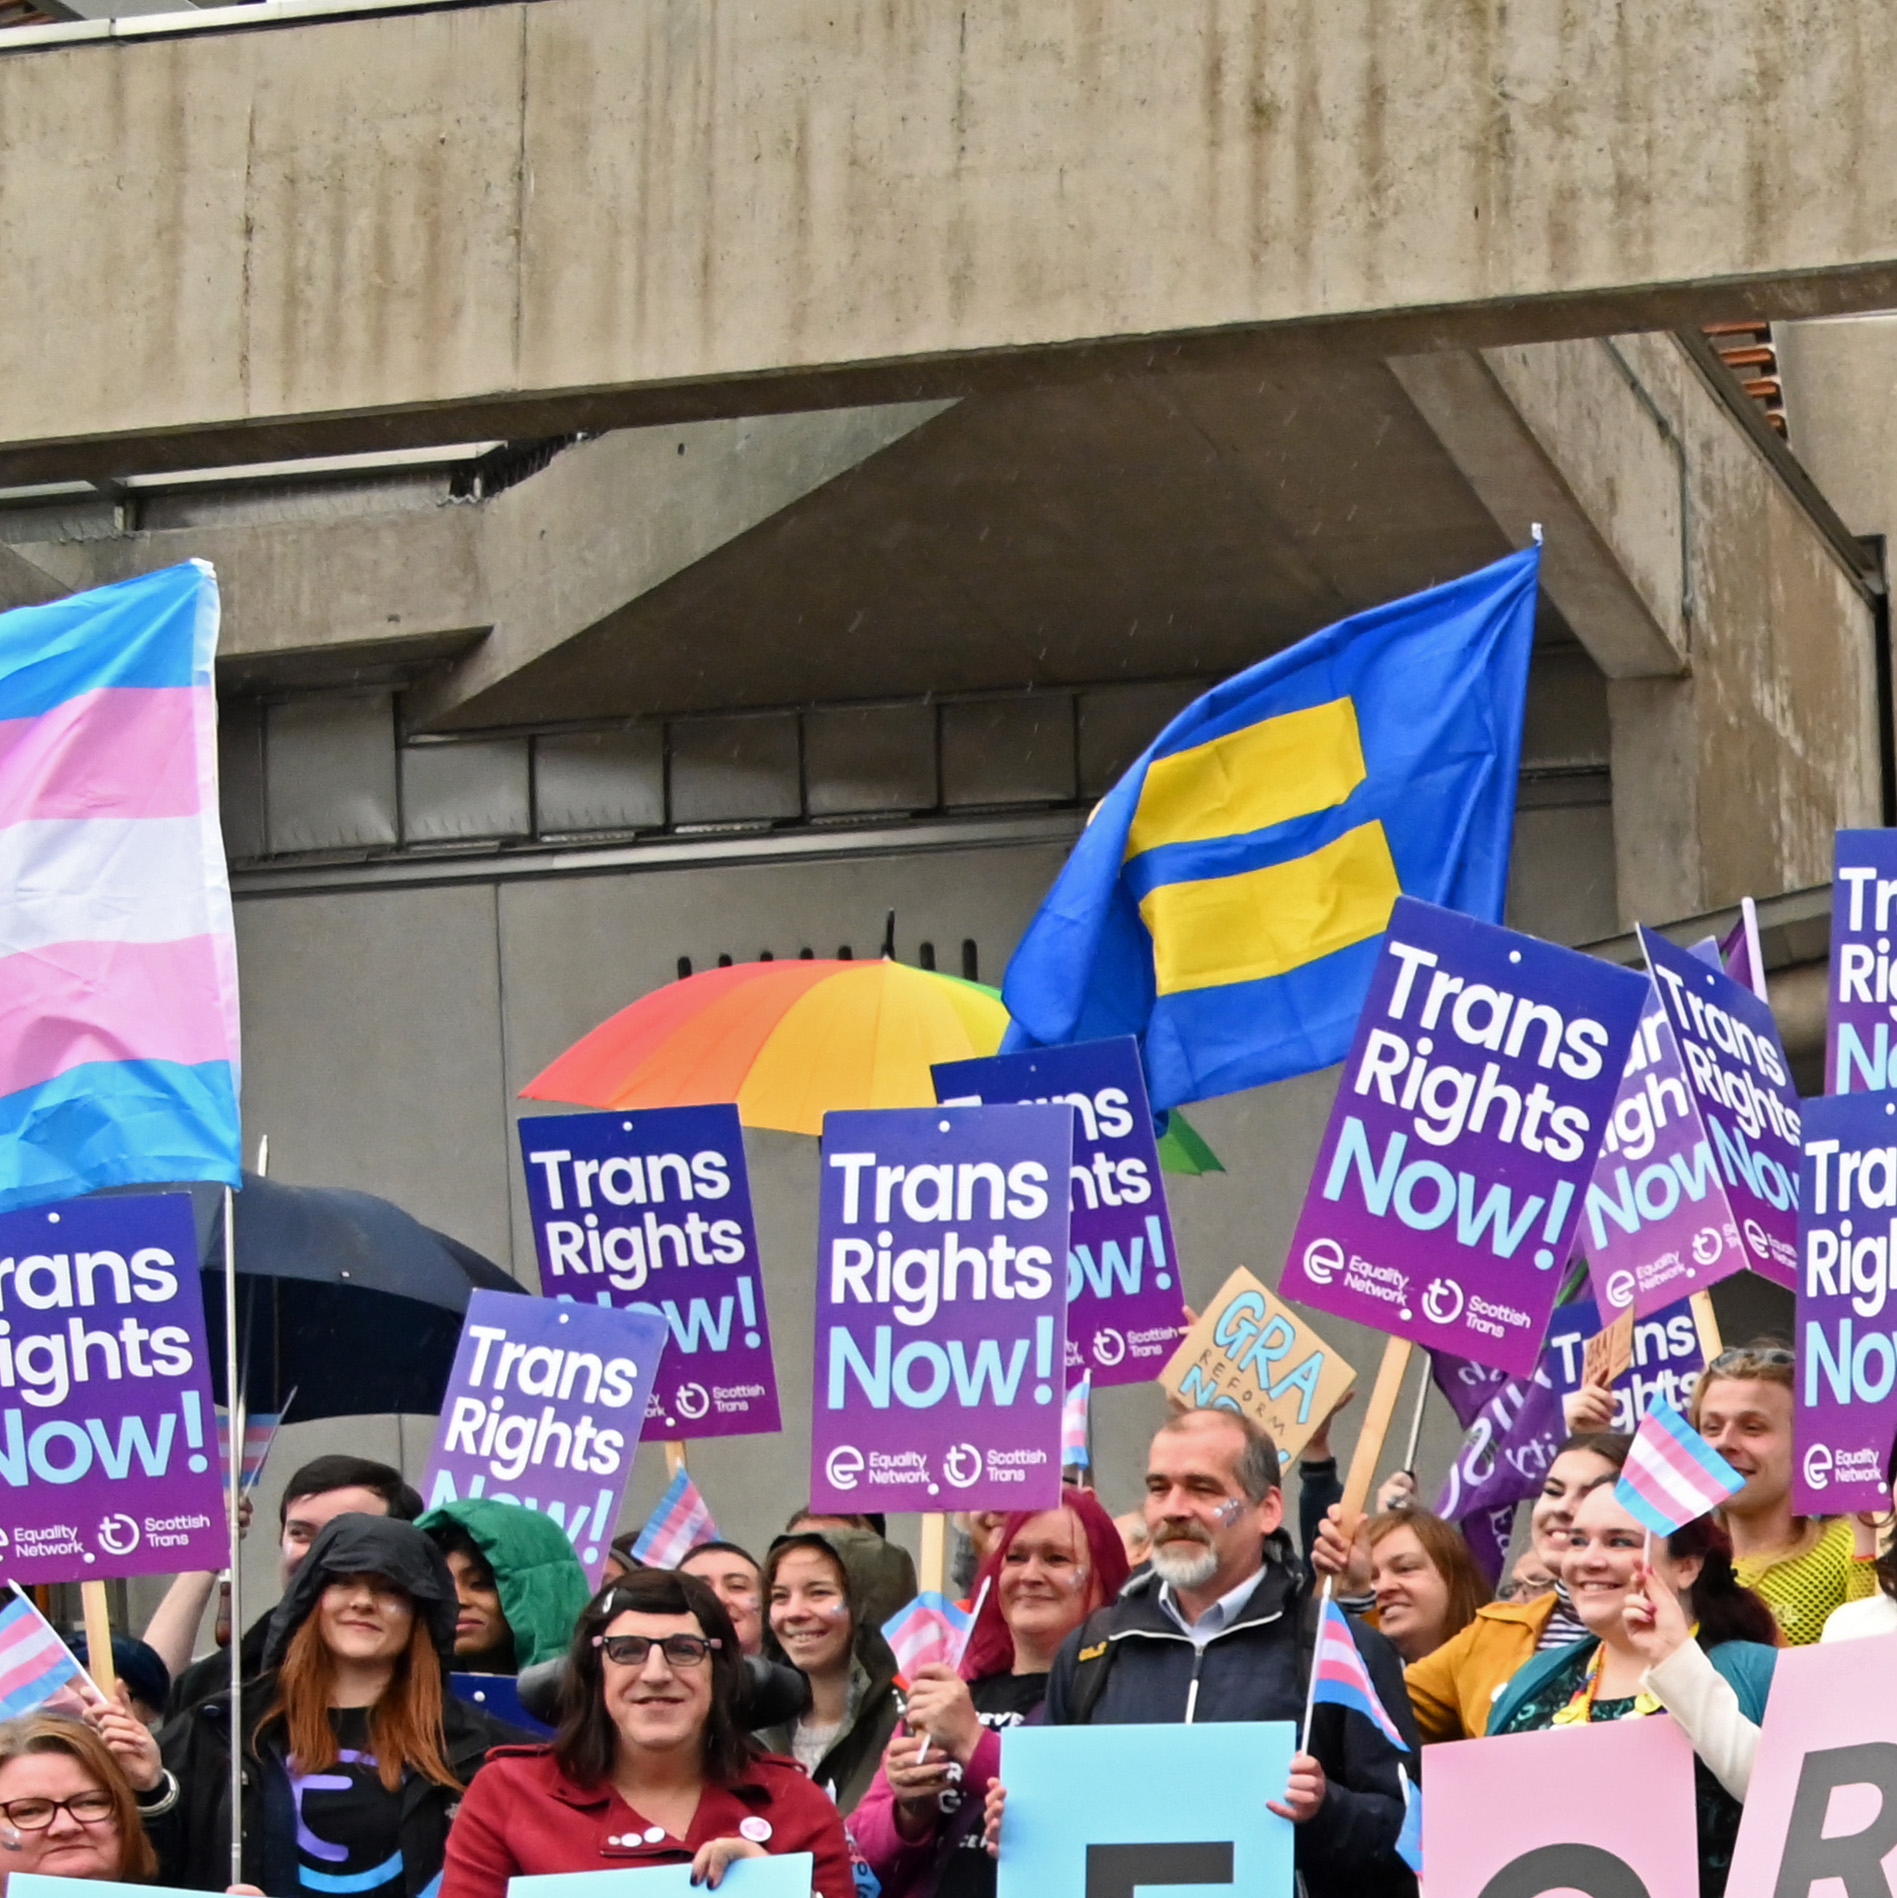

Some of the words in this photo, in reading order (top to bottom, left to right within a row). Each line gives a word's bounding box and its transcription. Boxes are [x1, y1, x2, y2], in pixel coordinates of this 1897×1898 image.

[1387, 941, 1609, 1080] Trans
[1655, 964, 1786, 1087] Trans
[1354, 1029, 1589, 1162] Rights
[1682, 1038, 1800, 1147] Rights
[530, 1150, 731, 1209] Trans
[830, 1152, 1049, 1224] Trans
[1322, 1116, 1574, 1270] Now!
[546, 1212, 746, 1290] Rights
[1636, 1252, 1680, 1280] Equality
[0, 1247, 178, 1311] rans
[830, 1231, 1053, 1326] Rights
[1348, 1255, 1409, 1287] Equality
[1638, 1266, 1688, 1292] Network
[1343, 1276, 1408, 1306] Network
[1465, 1313, 1505, 1338] Trans
[1468, 1295, 1531, 1328] Scottish
[1128, 1326, 1178, 1345] Scottish
[1131, 1342, 1163, 1358] Trans
[1551, 1315, 1696, 1384] Tns
[0, 1318, 193, 1407] ights
[468, 1325, 638, 1408] Trans
[827, 1315, 1054, 1409] Now!
[1213, 1290, 1324, 1425] GRA
[713, 1383, 765, 1400] Scottish
[714, 1400, 749, 1413] Trans
[1199, 1348, 1286, 1437] REFORM
[444, 1396, 624, 1481] Rights
[869, 1451, 927, 1470] Equality
[986, 1449, 1047, 1466] Scottish
[1834, 1448, 1880, 1467] Equality
[1835, 1464, 1882, 1482] Network
[869, 1469, 930, 1484] Network
[986, 1466, 1026, 1482] Trans
[14, 1524, 78, 1544] Equality
[145, 1514, 210, 1533] Scottish
[146, 1531, 189, 1548] Trans
[15, 1537, 84, 1558] Network
